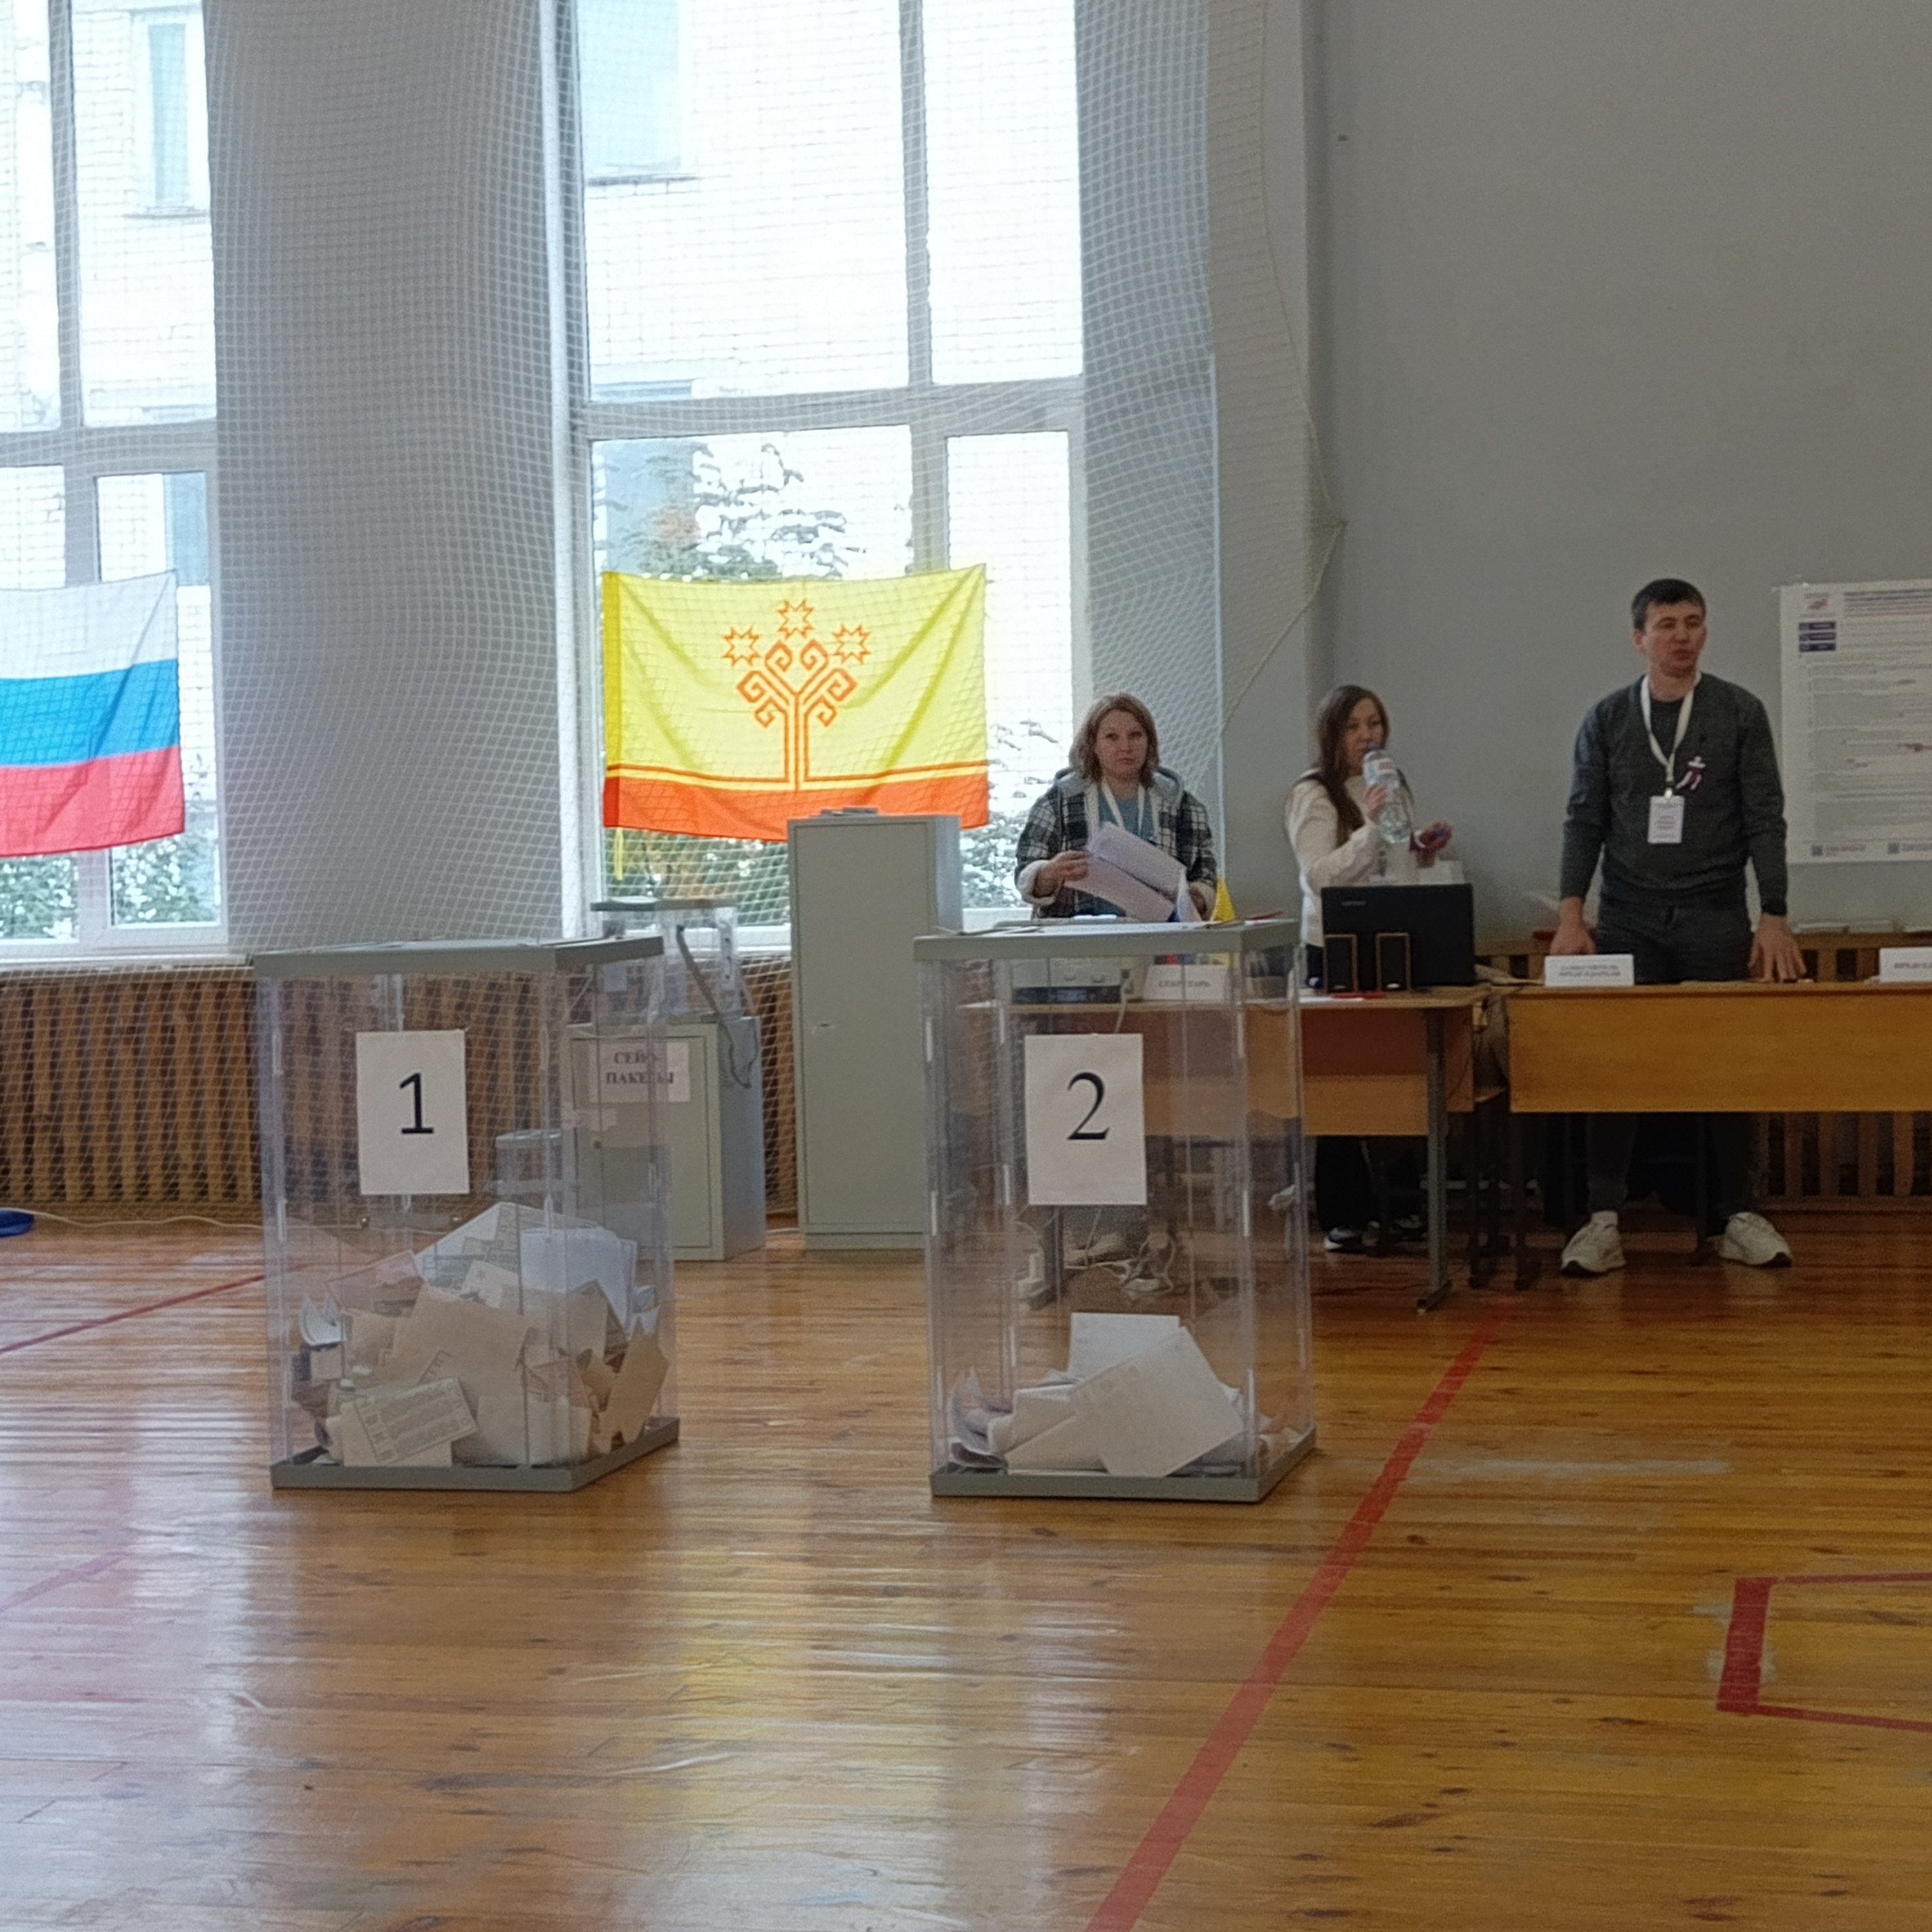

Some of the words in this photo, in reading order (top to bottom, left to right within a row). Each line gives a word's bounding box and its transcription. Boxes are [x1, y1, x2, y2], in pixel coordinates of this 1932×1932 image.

[400, 1072, 434, 1135] 1
[606, 1072, 674, 1085] ПАКЕЫ
[1066, 1072, 1110, 1141] 2
